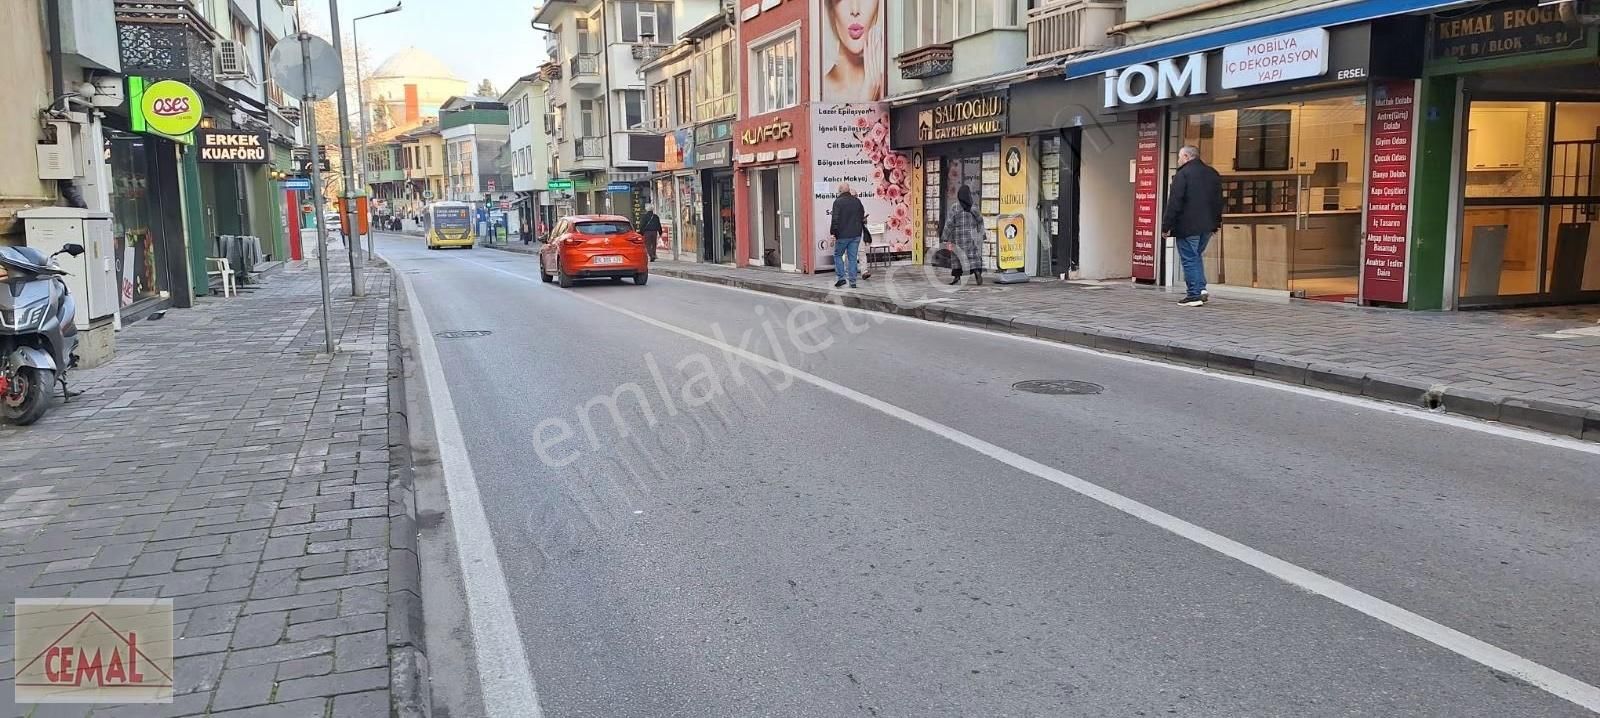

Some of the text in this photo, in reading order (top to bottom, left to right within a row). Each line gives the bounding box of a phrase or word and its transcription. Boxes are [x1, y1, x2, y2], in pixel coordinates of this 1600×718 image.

[1440, 14, 1494, 39] KEMAL
[1247, 38, 1298, 56] MOBİLYA
[1488, 36, 1522, 52] BLOK
[1225, 49, 1320, 75] İÇ DEKORASYON
[1258, 70, 1283, 82] YAPI
[1337, 67, 1366, 80] ERSEL
[741, 116, 793, 145] KUAFÖR
[206, 134, 260, 147] ERKEK
[202, 148, 266, 161] KUAFÖRÜ
[1391, 203, 1407, 211] Parke
